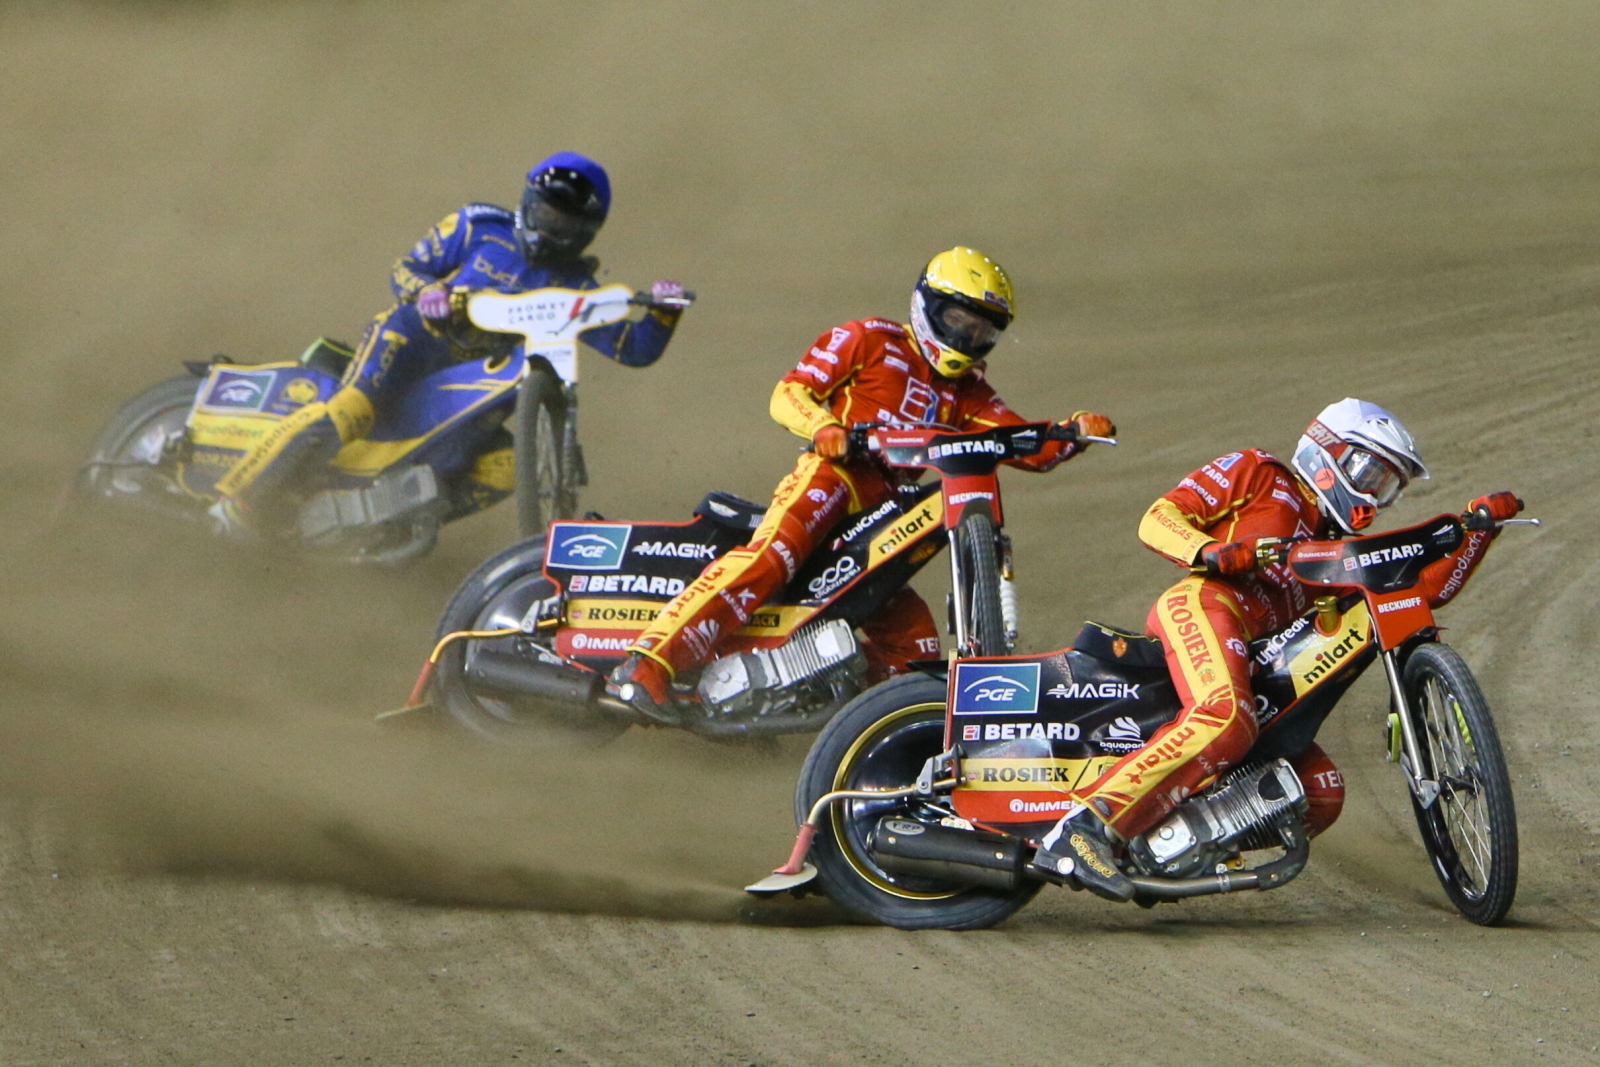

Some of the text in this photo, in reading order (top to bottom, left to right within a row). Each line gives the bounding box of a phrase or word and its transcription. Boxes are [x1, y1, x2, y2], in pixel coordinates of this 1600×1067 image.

[940, 439, 1006, 457] BETARD
[842, 499, 898, 543] UniCredit
[878, 507, 935, 556] milart
[568, 544, 608, 559] PGE
[1359, 543, 1425, 568] BETARD
[1438, 530, 1487, 600] uperpolisa
[587, 574, 686, 597] BETARD
[1377, 597, 1422, 614] BECKHOFF
[1166, 593, 1214, 673] ROSIEK
[1255, 617, 1310, 666] UniCredit
[1303, 627, 1366, 685] milart
[974, 688, 1017, 702] PGE
[984, 722, 1081, 742] BETARD
[1124, 726, 1196, 785] milart
[982, 767, 1070, 783] ROSIEK
